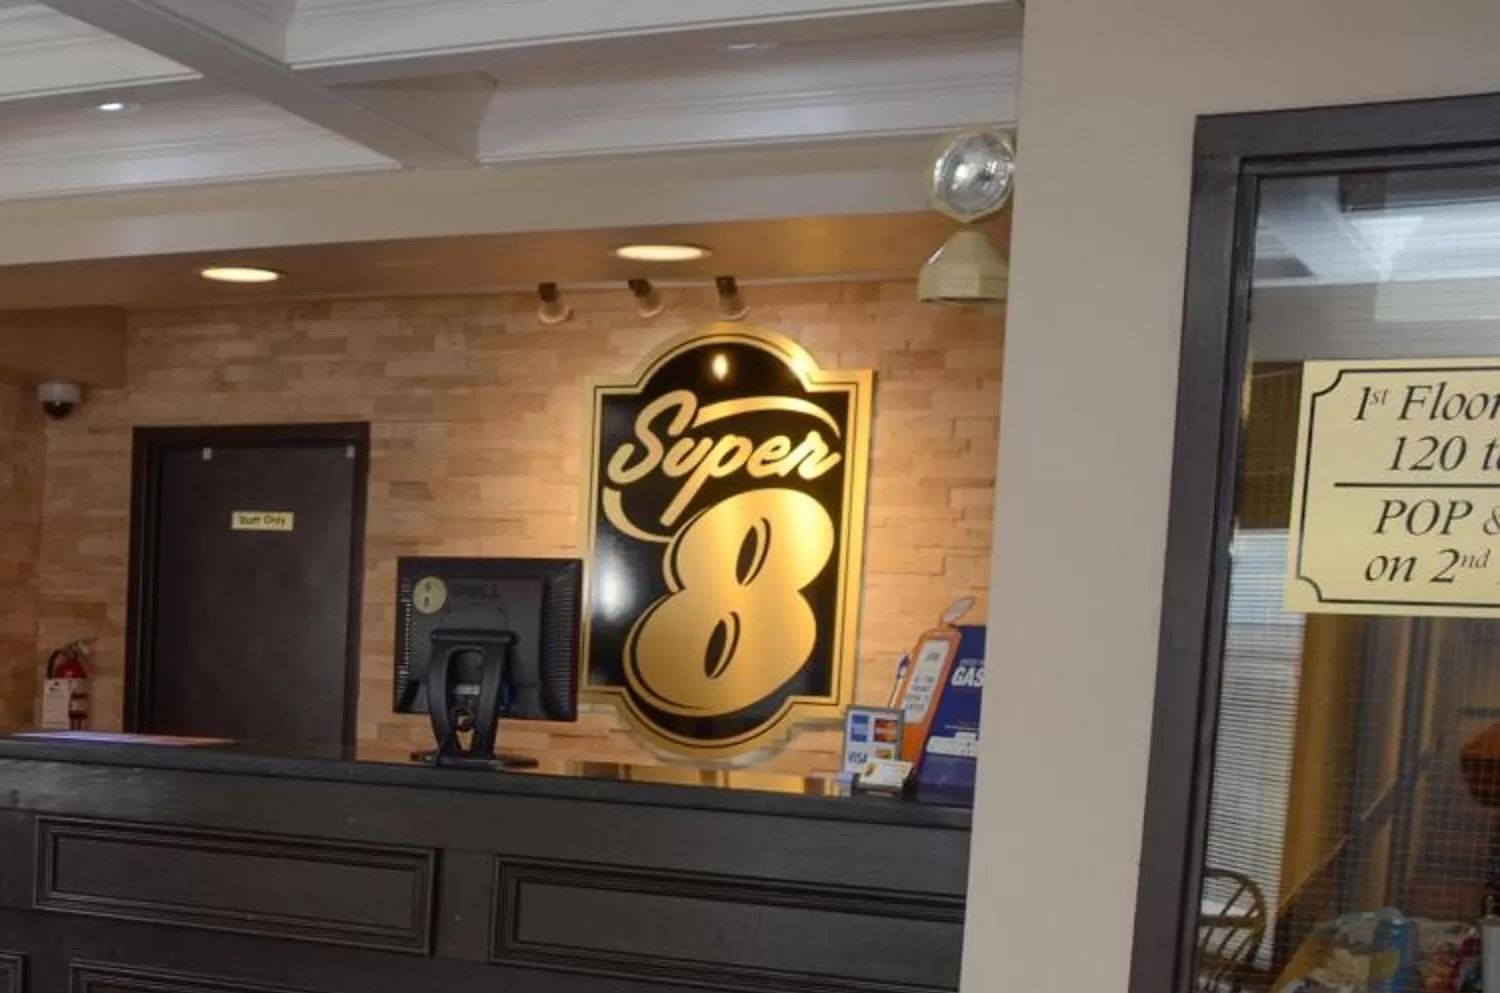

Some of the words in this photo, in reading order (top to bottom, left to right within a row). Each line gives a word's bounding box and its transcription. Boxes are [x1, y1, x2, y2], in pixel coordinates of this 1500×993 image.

[607, 390, 843, 527] Super
[1388, 434, 1467, 471] 120
[1373, 498, 1473, 536] POP
[1364, 554, 1418, 582] on
[1429, 547, 1492, 583] 2nd
[623, 487, 835, 717] 8
